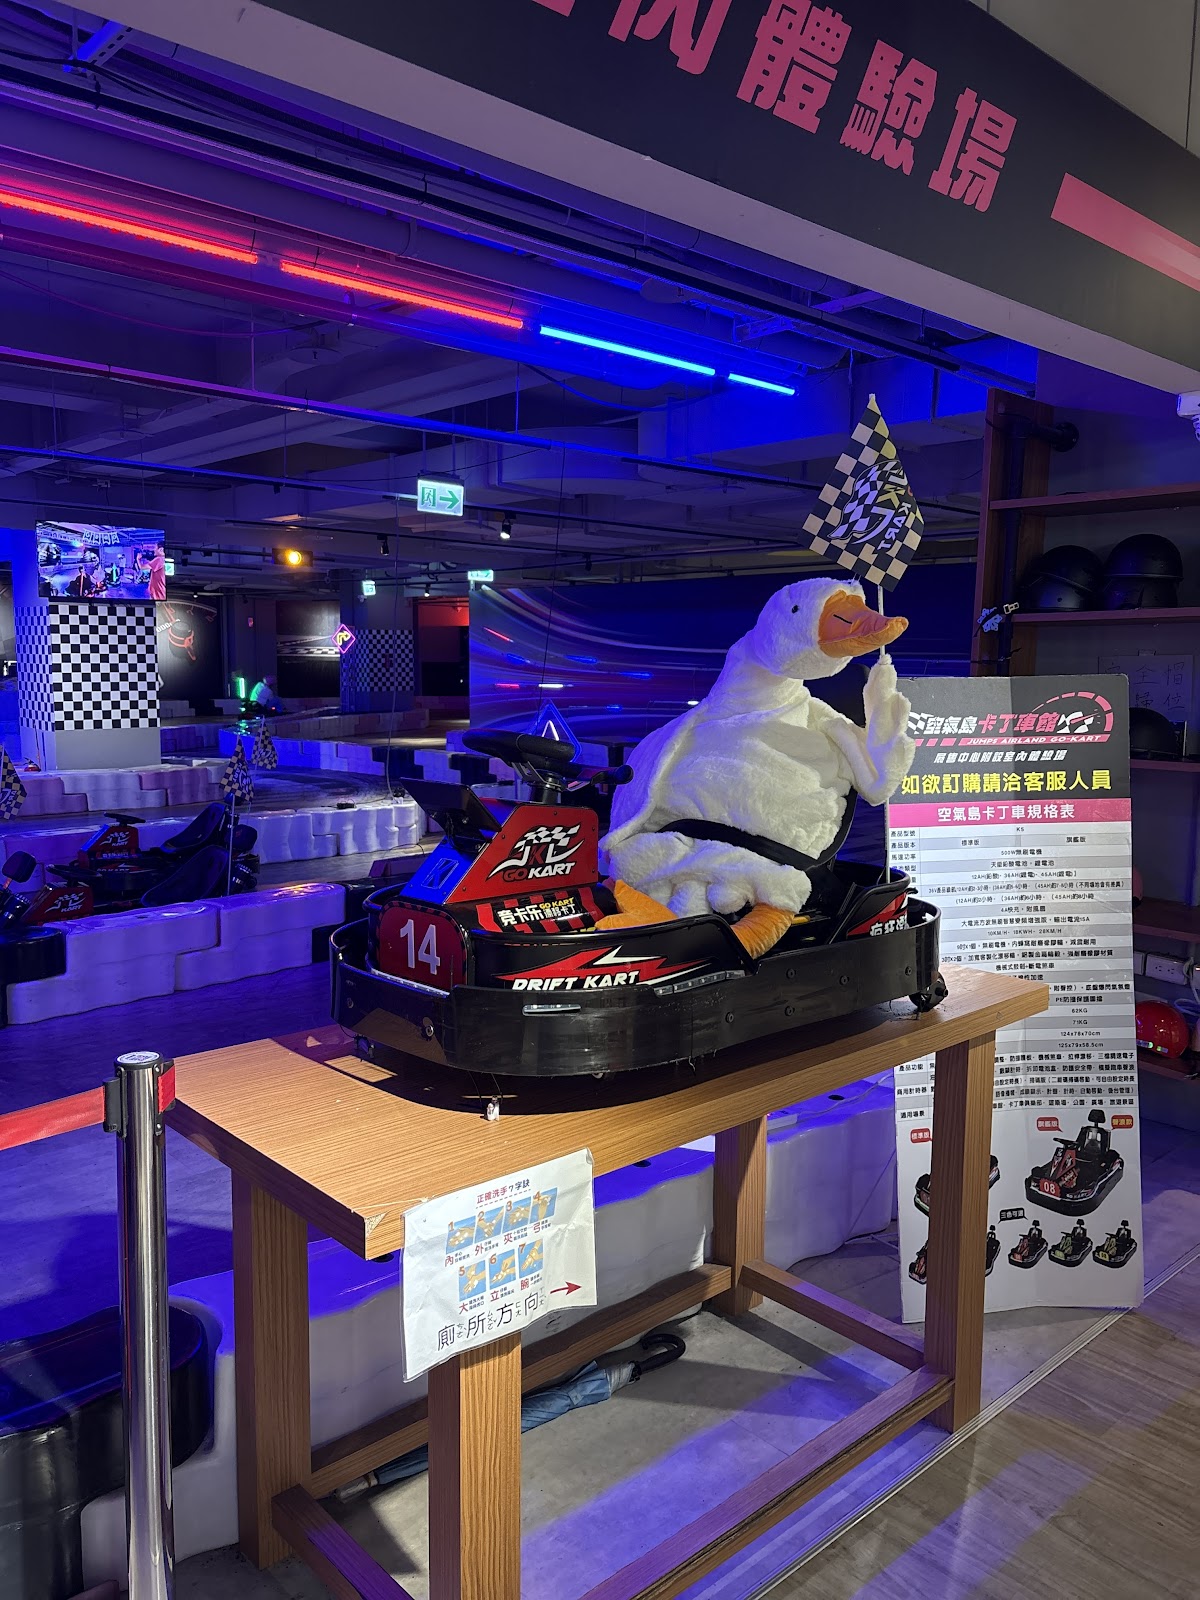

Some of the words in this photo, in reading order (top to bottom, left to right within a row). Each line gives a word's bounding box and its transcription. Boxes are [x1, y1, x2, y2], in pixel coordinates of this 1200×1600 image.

[533, 0, 1017, 212] 體驗場
[923, 713, 1061, 735] 空氣島卡丁車館
[1050, 735, 1101, 743] GO-KART
[934, 750, 1068, 764] 展售中心附設室內體驗場
[901, 770, 1113, 795] 如欲訂購請洽客服人員
[938, 804, 1076, 823] 空氣島卡丁車規格表
[503, 867, 528, 881] GO
[527, 862, 576, 879] KART
[539, 902, 552, 910] GO
[552, 896, 575, 908] KART
[400, 918, 440, 976] 14
[512, 977, 579, 991] DRIFT
[583, 970, 640, 989] KART
[1043, 1182, 1056, 1194] 08
[448, 1221, 455, 1232] 1
[477, 1211, 485, 1222] 2
[506, 1200, 513, 1212] 3
[459, 1266, 465, 1276] 5
[490, 1253, 497, 1264] 6
[519, 1243, 526, 1254] 7
[459, 1302, 469, 1315] 大
[490, 1290, 500, 1302] 立
[437, 1292, 540, 1351] 廁所方向
